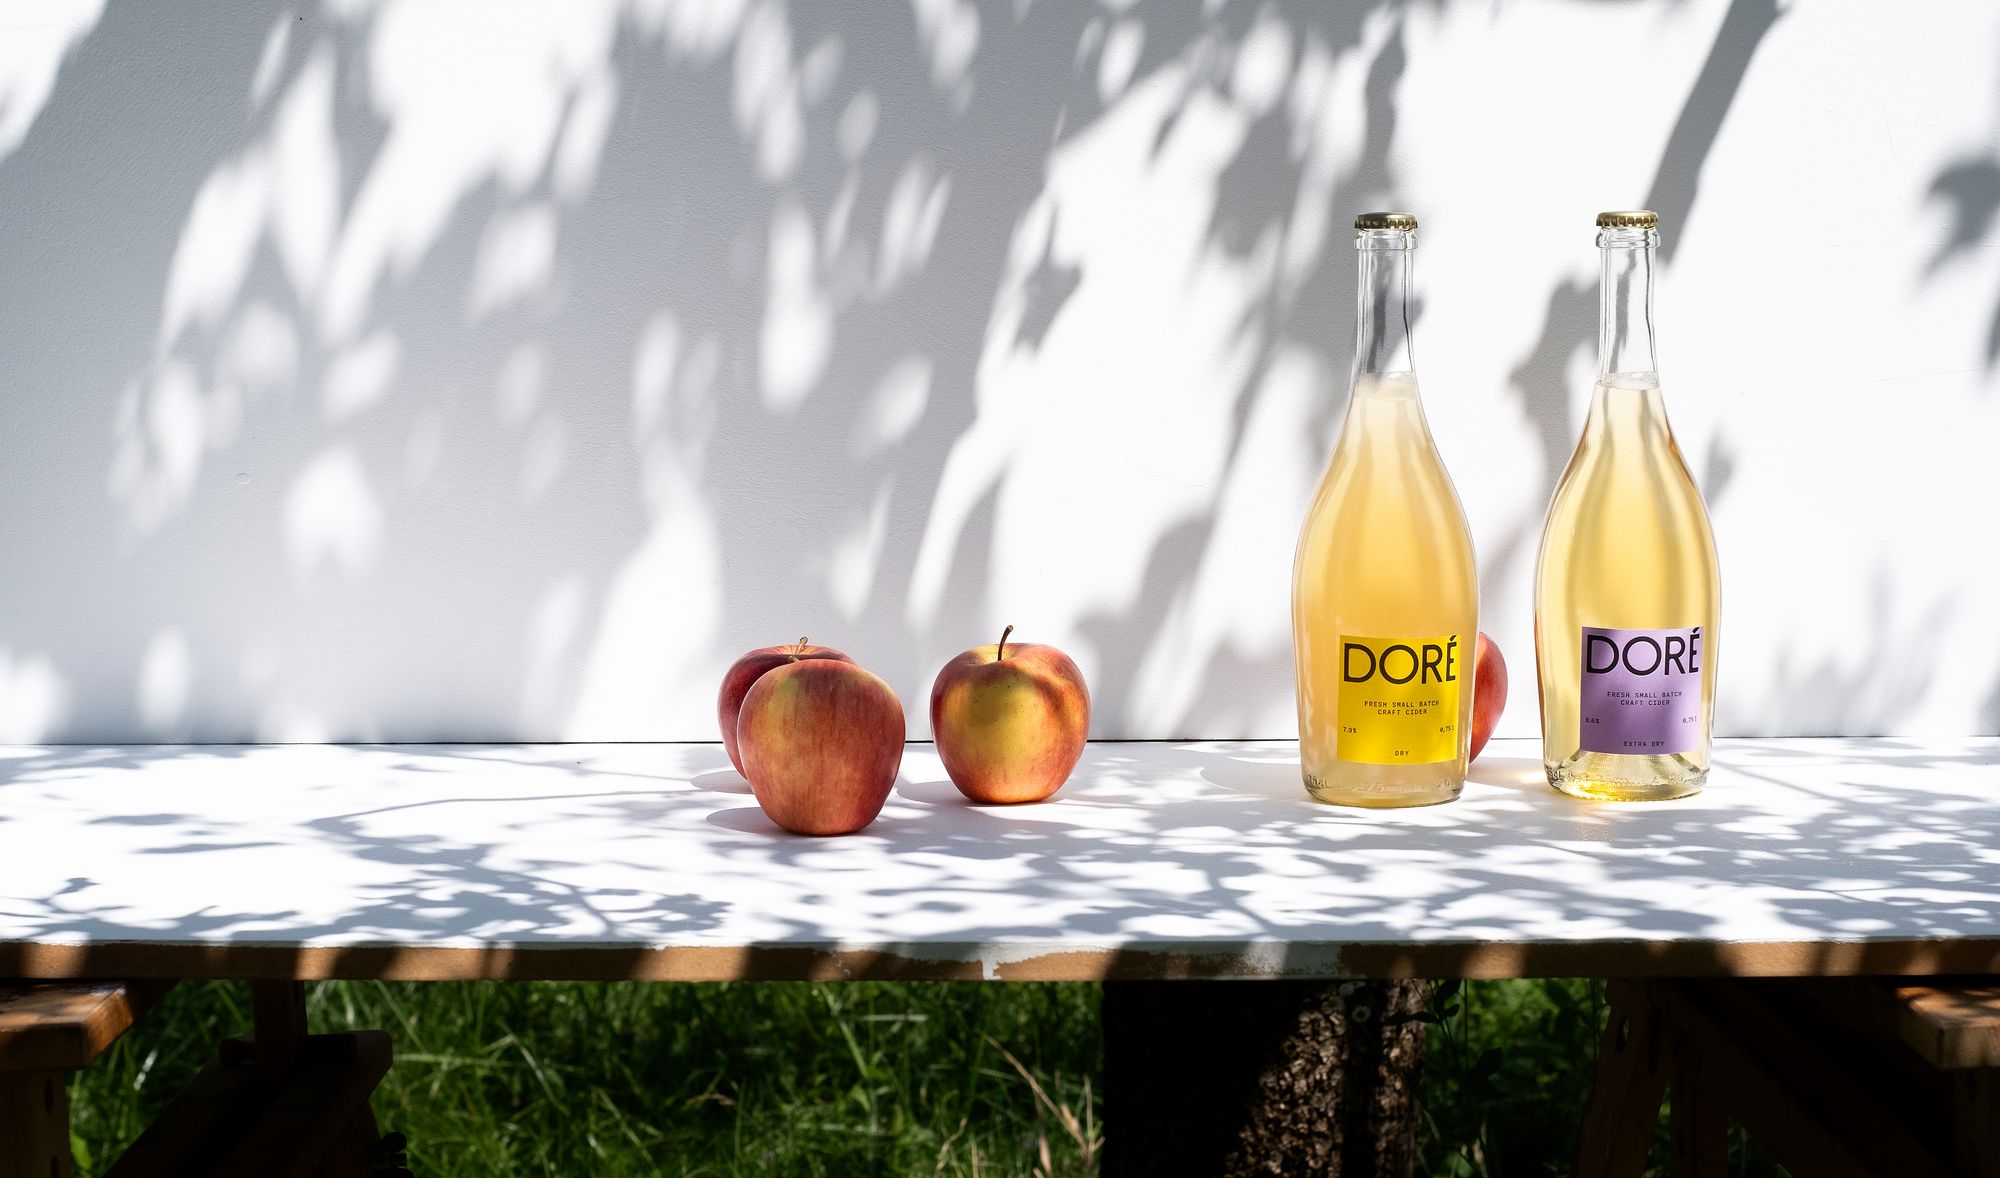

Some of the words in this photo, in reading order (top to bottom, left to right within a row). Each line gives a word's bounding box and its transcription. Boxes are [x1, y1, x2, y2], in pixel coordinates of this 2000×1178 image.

[1343, 634, 1457, 685] DORÉ
[1586, 626, 1700, 676] DORÉ
[1364, 700, 1387, 708] FRESH
[1377, 708, 1401, 716] CRAFT
[1405, 708, 1428, 716] CIDER
